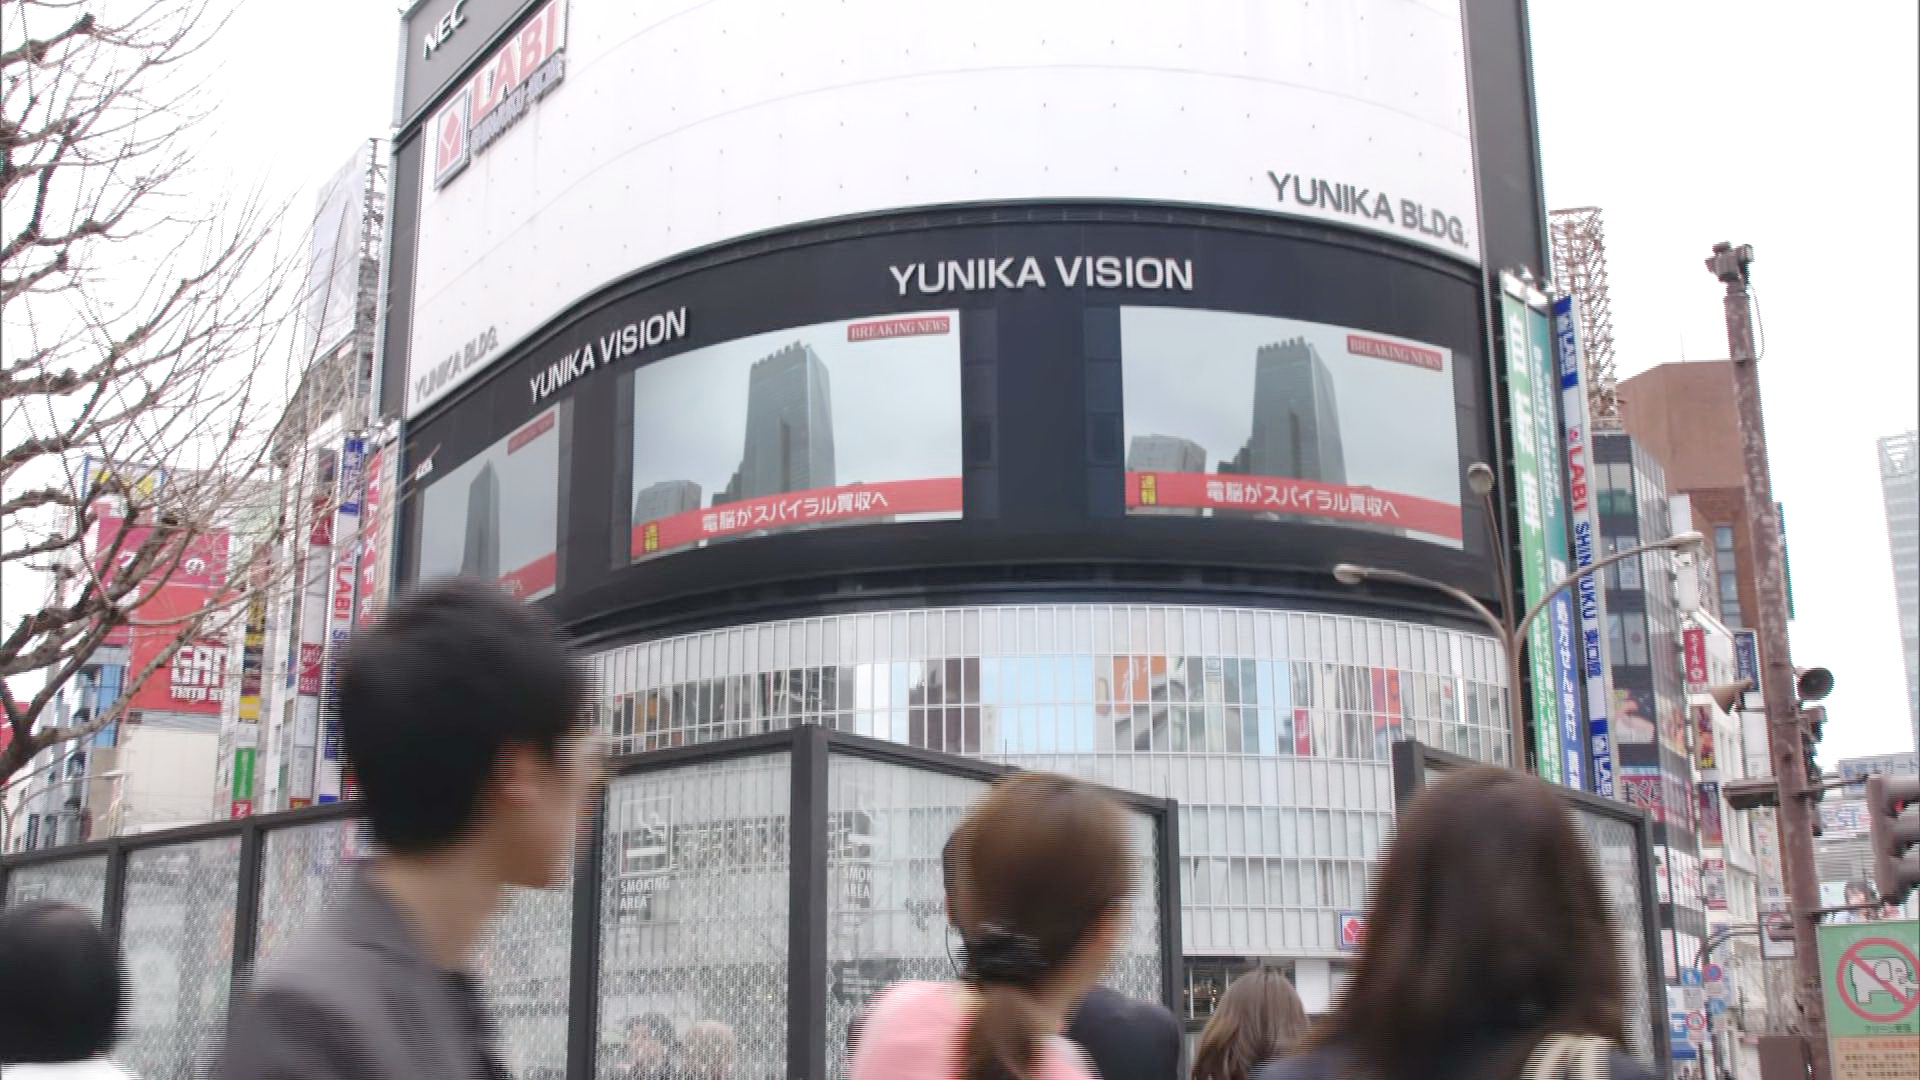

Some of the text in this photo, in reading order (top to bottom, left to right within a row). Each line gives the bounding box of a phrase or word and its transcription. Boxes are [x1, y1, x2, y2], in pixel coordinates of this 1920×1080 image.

[423, 0, 466, 60] NEC
[471, 0, 557, 127] LABI
[1267, 171, 1470, 247] YUNIKA BLDG.
[889, 256, 1193, 296] YUNIKA VISION
[529, 305, 687, 404] YUNIKA VISION
[850, 318, 949, 340] BREAKING NEWS
[1349, 338, 1442, 369] BREAKING NEWS
[415, 350, 462, 403] YUNIKA
[1205, 481, 1400, 519] 電脳がスパイラル買収へ
[1568, 445, 1588, 513] LABI
[702, 491, 889, 533] 電脳がスパイラル買収へ
[334, 566, 353, 619] LABI
[1575, 521, 1597, 619] SHINUKU
[620, 876, 670, 895] SMOKING
[620, 895, 648, 912] AREA
